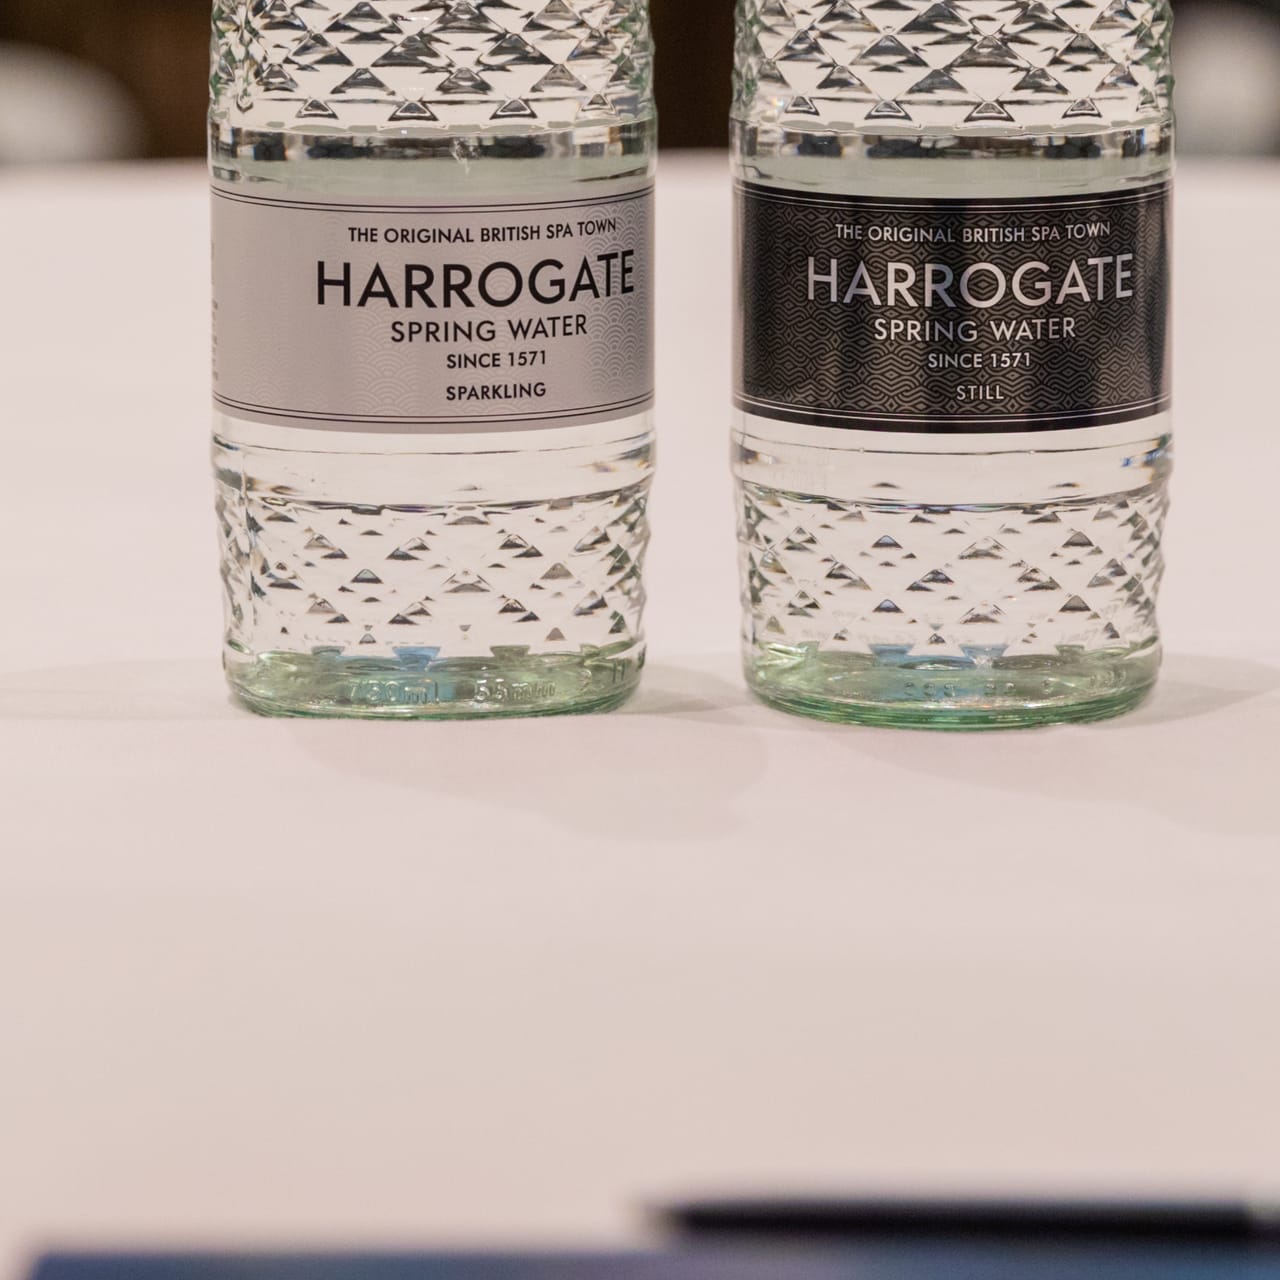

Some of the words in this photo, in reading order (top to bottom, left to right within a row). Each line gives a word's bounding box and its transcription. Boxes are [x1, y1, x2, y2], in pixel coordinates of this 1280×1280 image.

[348, 227, 378, 243] THE
[383, 227, 474, 244] ORIGINAL
[480, 224, 541, 243] BRITISH
[546, 222, 573, 239] SPA
[577, 218, 617, 236] TOWN
[835, 223, 863, 240] THE
[868, 225, 956, 244] ORIGINAL
[963, 227, 1025, 244] BRITISH
[1031, 225, 1061, 241] SPA
[1065, 221, 1111, 239] TOWN
[317, 249, 635, 308] HARROGATE
[806, 253, 1134, 308] HARROGATE
[391, 320, 496, 343] SPRING
[507, 314, 587, 340] WATER
[874, 318, 978, 342] SPRING
[990, 317, 1076, 341] WATER
[446, 353, 501, 369] SINCE
[508, 350, 546, 367] 1571
[928, 352, 983, 369] SINCE
[990, 351, 1031, 368] 1571
[446, 382, 546, 401] SPARKLING
[956, 385, 1005, 401] STILL
